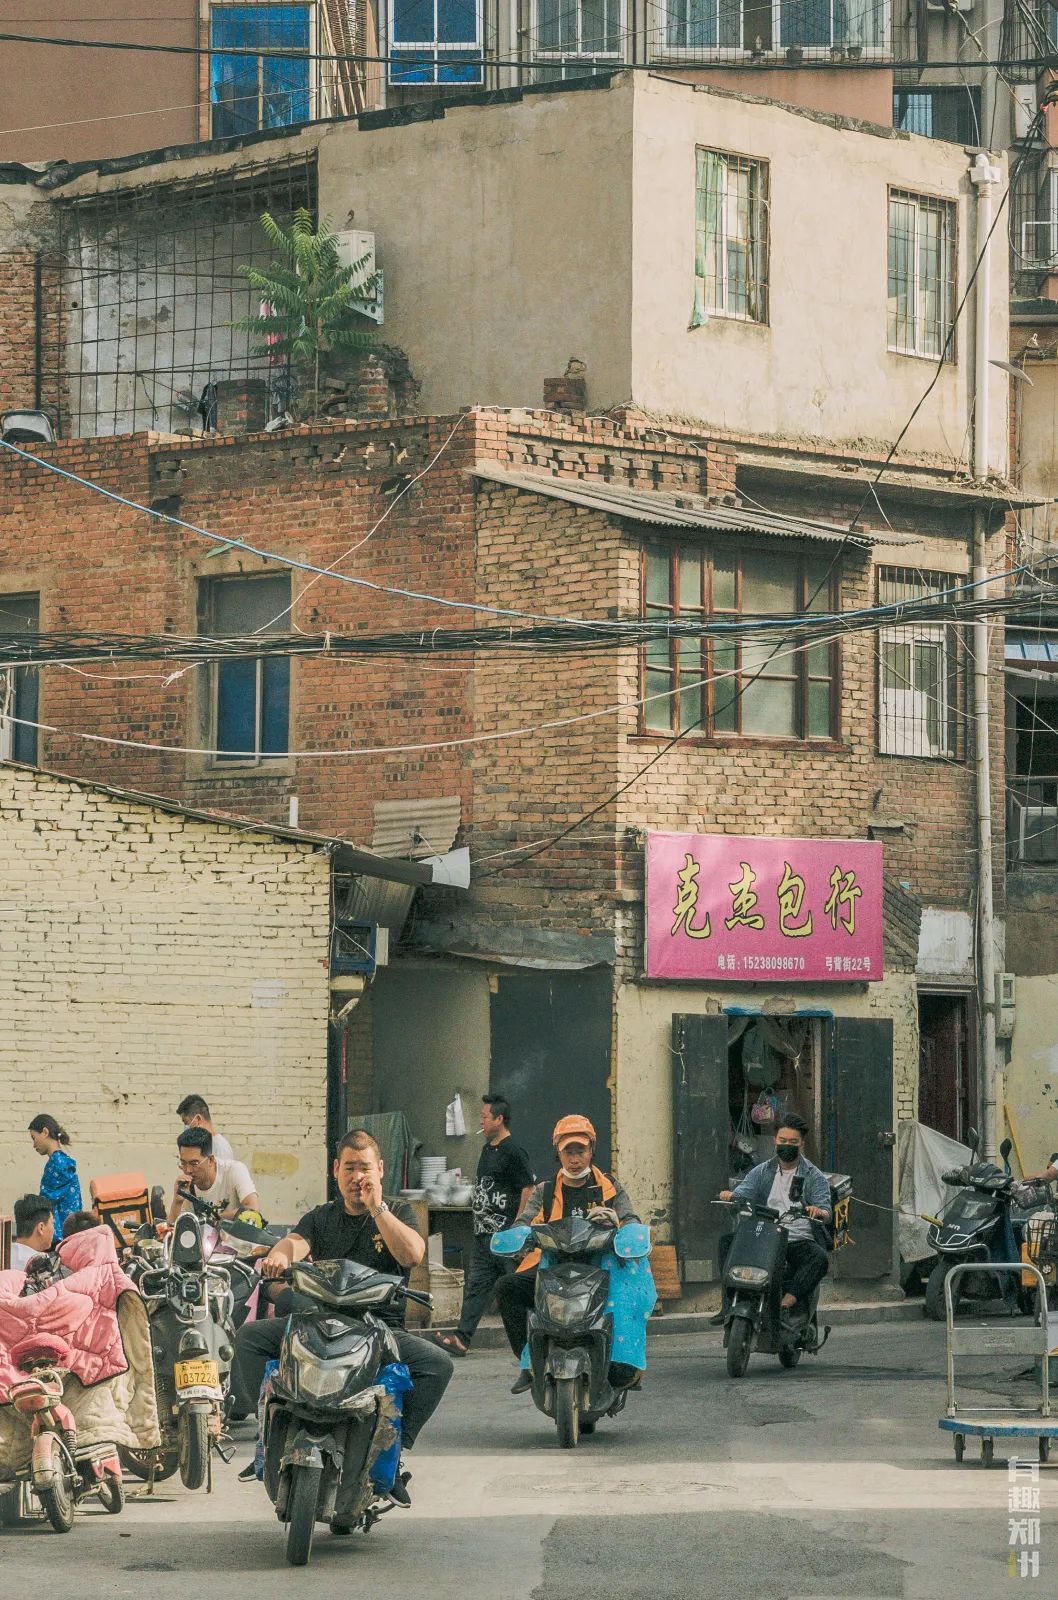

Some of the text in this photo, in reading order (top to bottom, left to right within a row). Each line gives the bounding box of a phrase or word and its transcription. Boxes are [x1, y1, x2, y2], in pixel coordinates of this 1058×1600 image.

[670, 853, 863, 939] 克杰包行
[491, 1191, 507, 1209] HG
